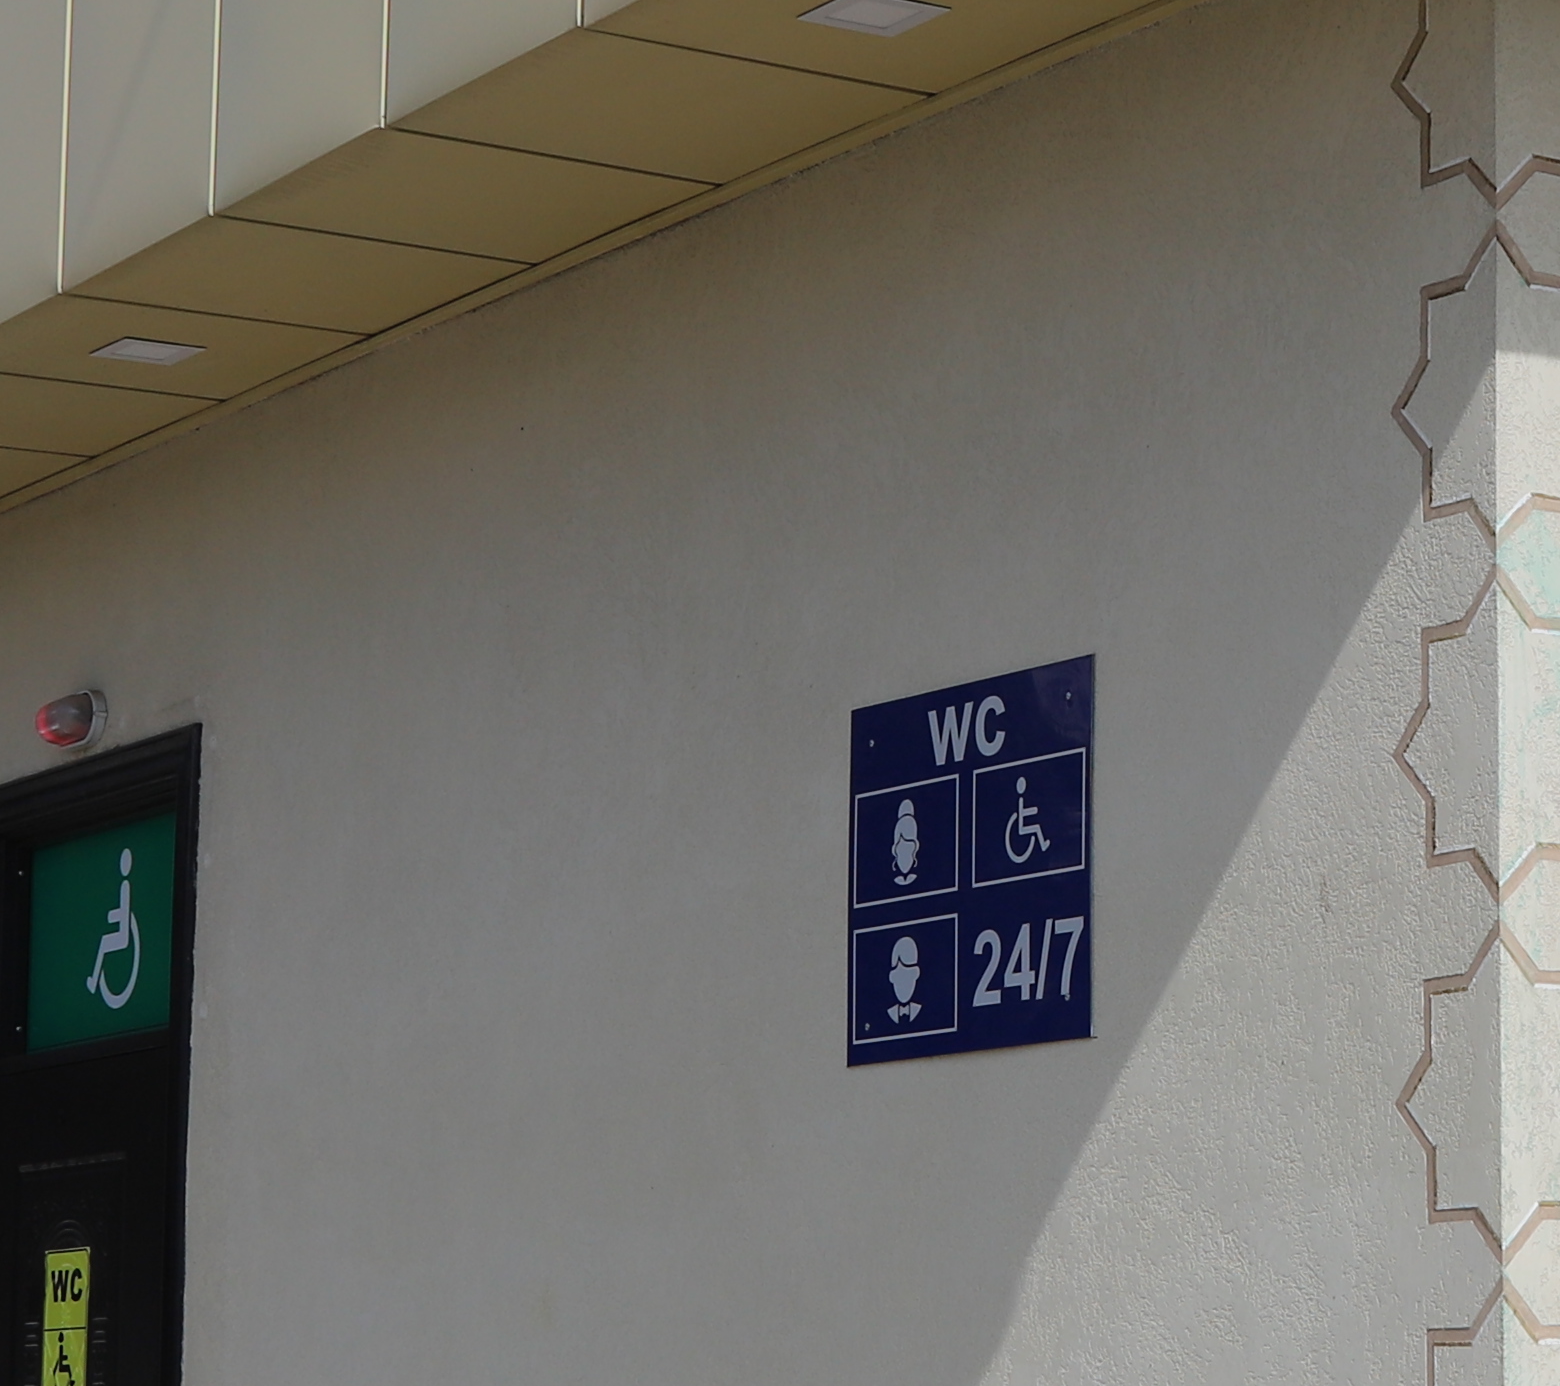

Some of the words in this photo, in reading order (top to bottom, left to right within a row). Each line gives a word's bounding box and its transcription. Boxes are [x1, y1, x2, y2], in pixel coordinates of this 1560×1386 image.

[927, 694, 1006, 766] WC
[972, 915, 1085, 1008] 24/7
[51, 1267, 83, 1303] WC
